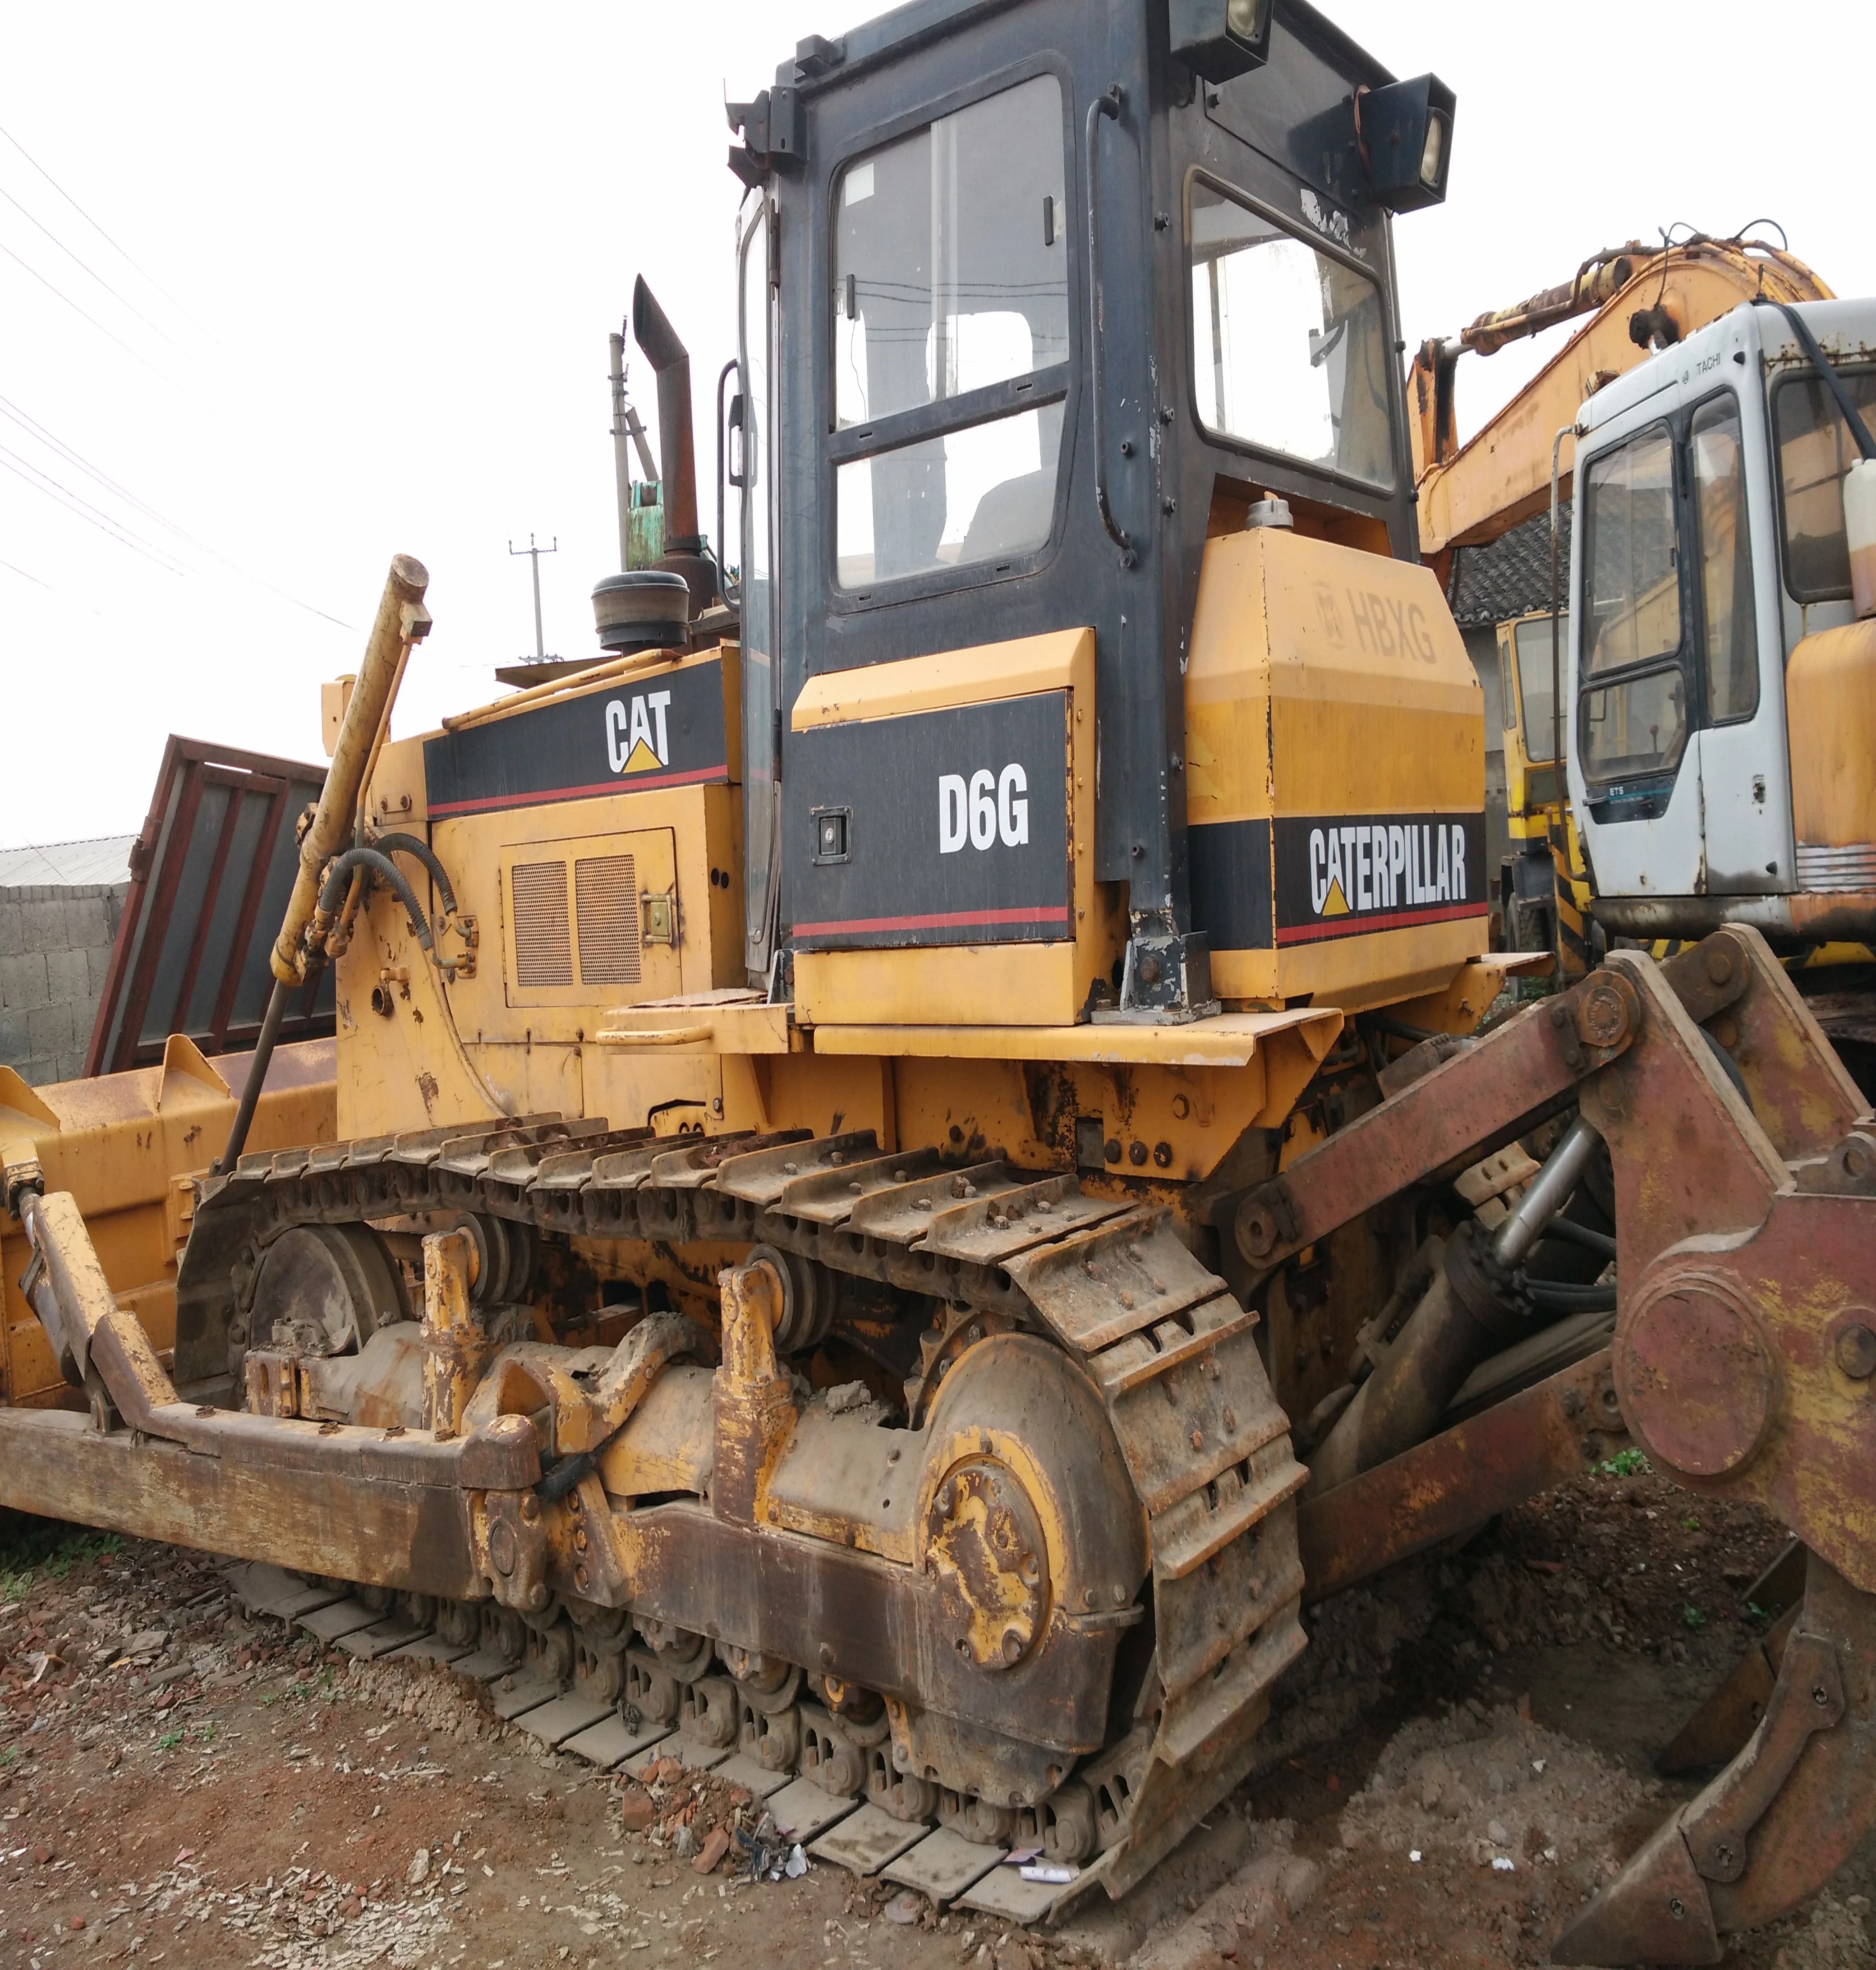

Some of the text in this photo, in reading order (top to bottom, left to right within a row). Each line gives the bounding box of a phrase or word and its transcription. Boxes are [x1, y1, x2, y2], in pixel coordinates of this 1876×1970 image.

[1346, 588, 1437, 665] HBXG
[606, 690, 671, 773] CAT
[938, 763, 1029, 854] D6G
[1310, 824, 1467, 915] CATERPILLAR
